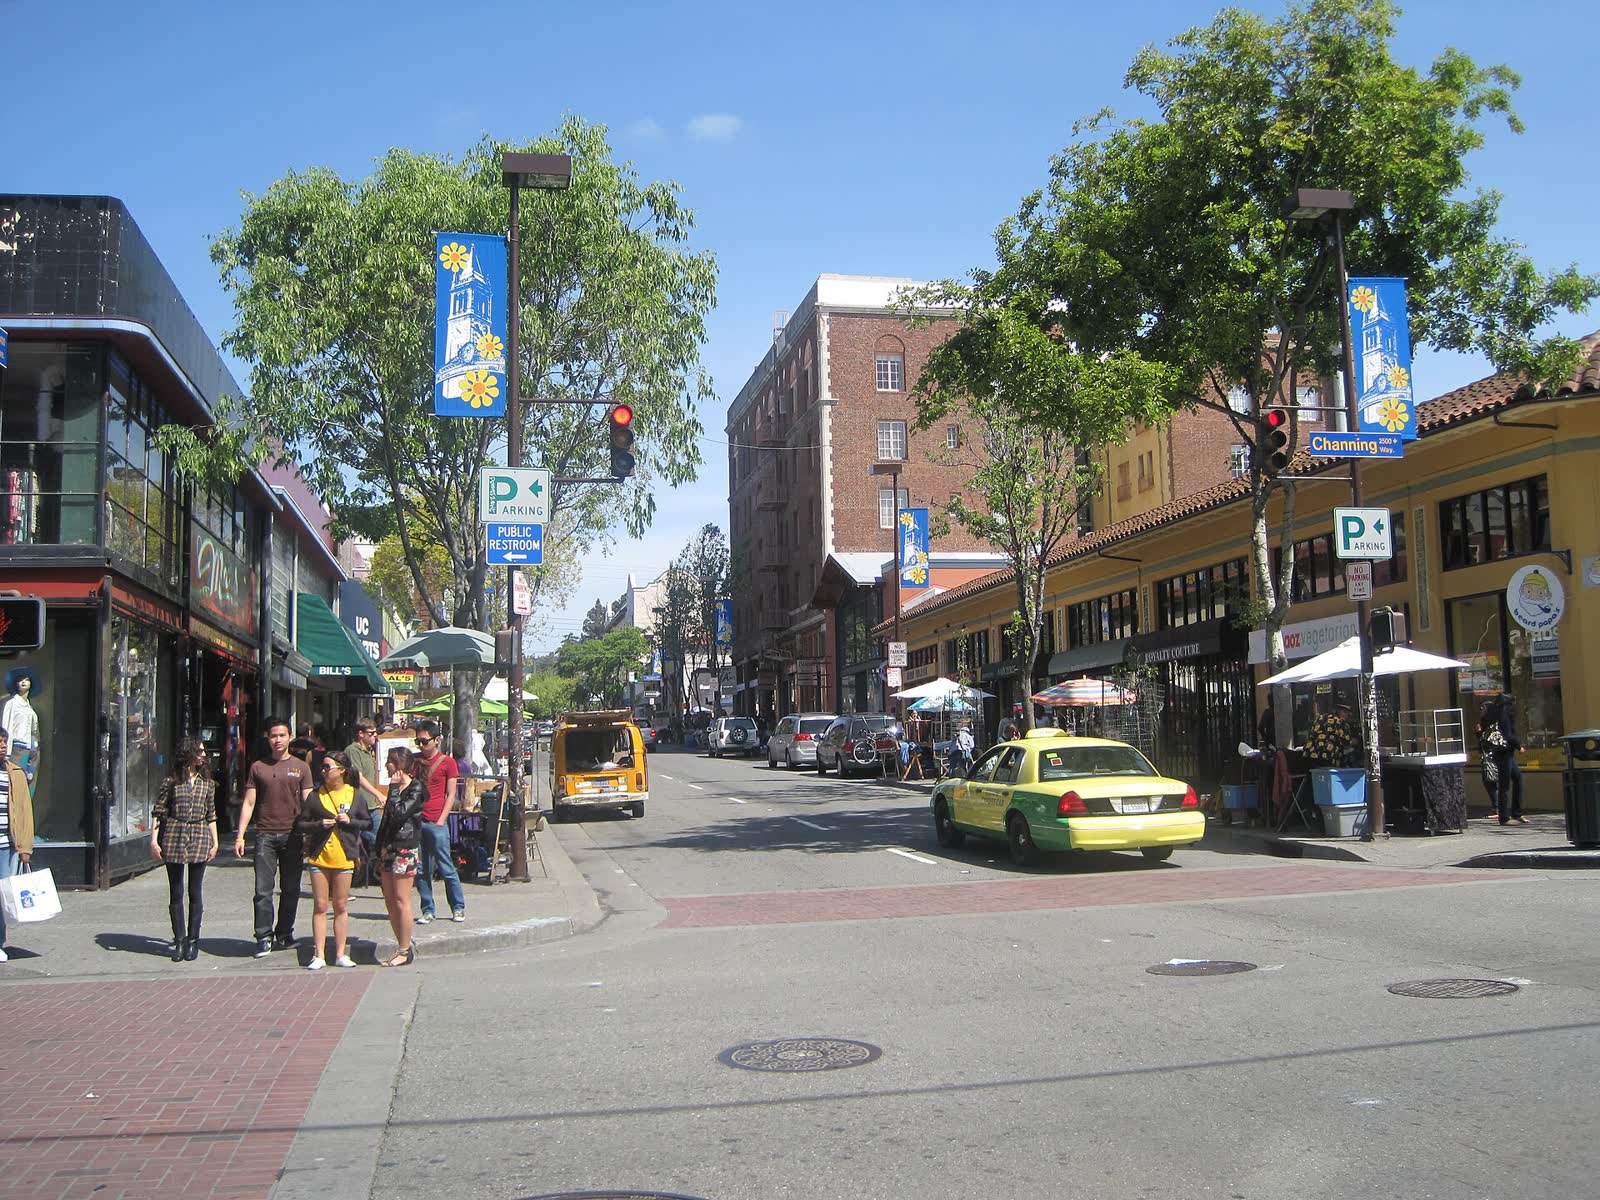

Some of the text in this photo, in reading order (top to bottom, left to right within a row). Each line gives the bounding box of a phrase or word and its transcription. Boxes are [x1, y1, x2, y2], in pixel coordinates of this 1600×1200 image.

[1312, 436, 1378, 454] Channing
[497, 526, 532, 538] PUBLIC
[489, 539, 540, 551] RESTROOM
[1348, 573, 1369, 581] PARKING
[1353, 566, 1364, 574] NO
[355, 615, 369, 636] UC
[1513, 608, 1537, 628] beard
[1282, 621, 1357, 652] aoz vegetarian
[1144, 643, 1200, 663] ROYALTY COUTURE
[319, 666, 352, 676] BILL'S
